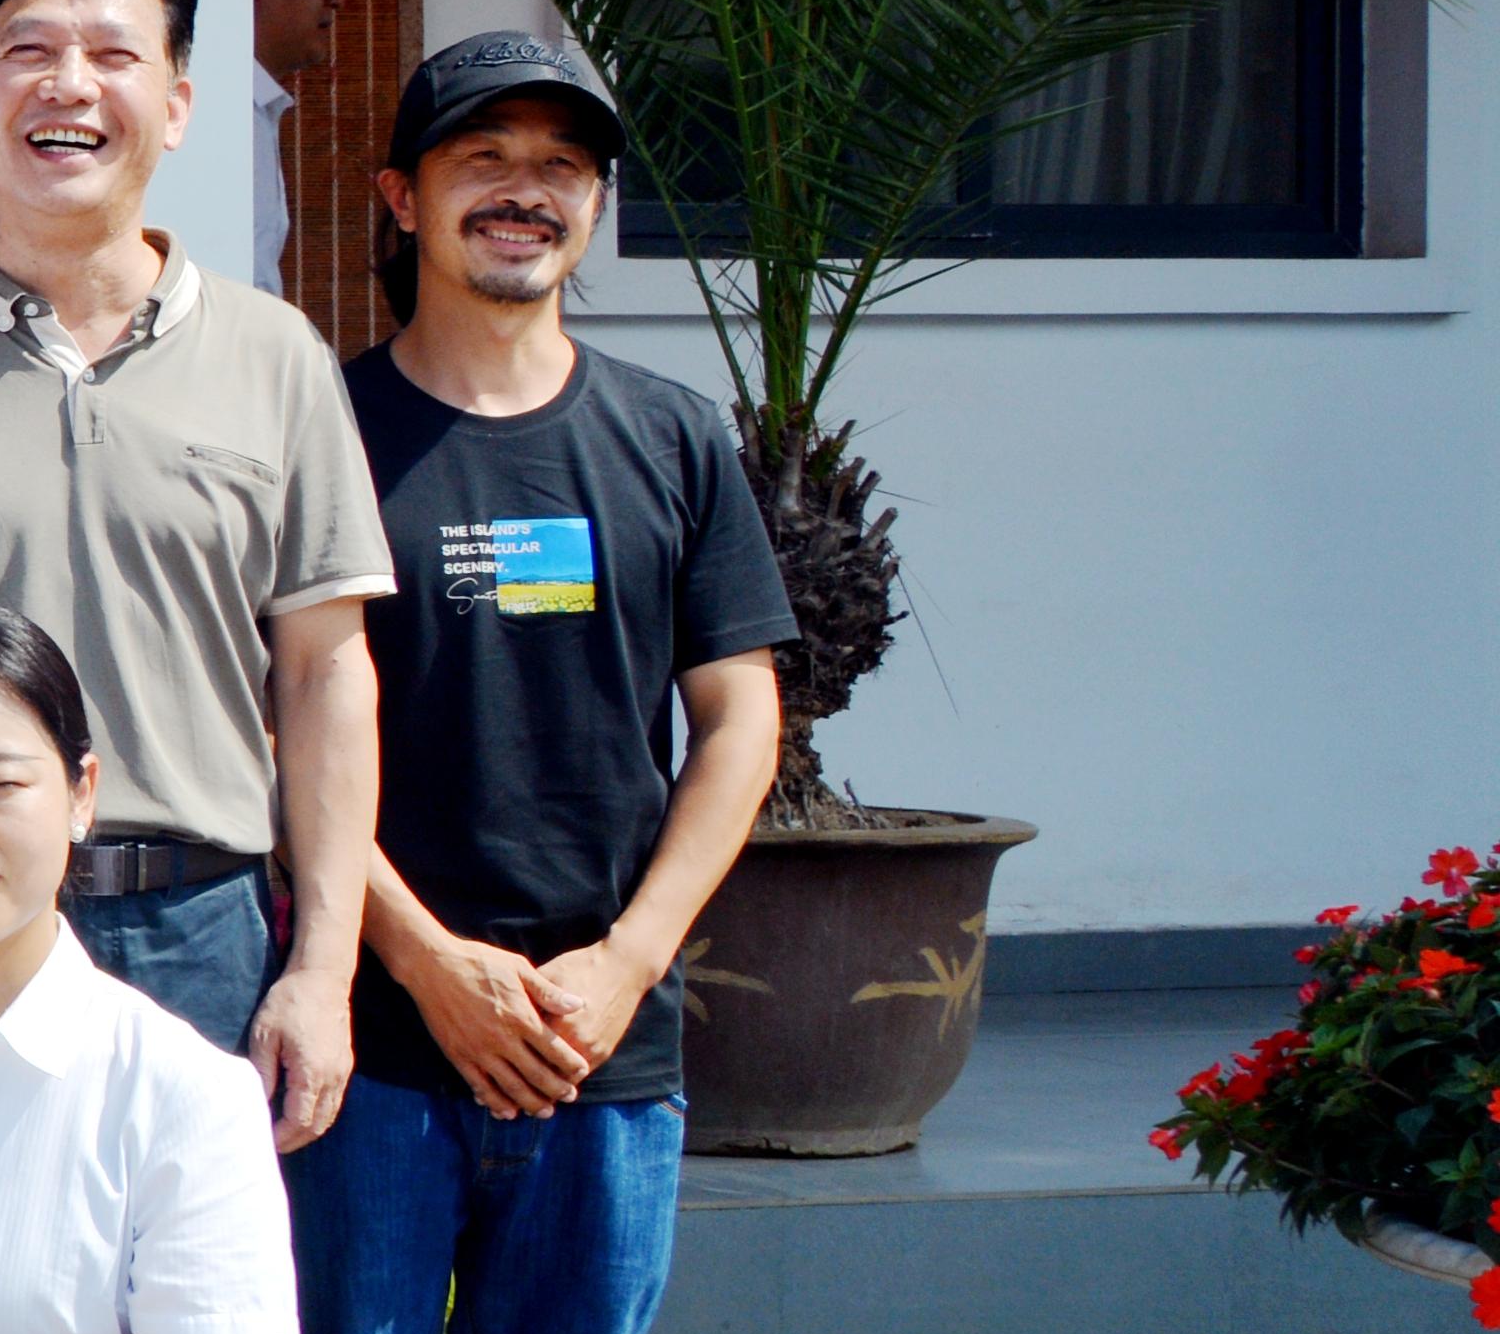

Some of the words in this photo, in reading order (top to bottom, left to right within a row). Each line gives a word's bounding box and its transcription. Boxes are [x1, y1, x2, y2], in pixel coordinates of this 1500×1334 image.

[440, 526, 468, 537] THE
[470, 524, 531, 536] ISLAND'S
[442, 541, 540, 556] SPECTACULAR
